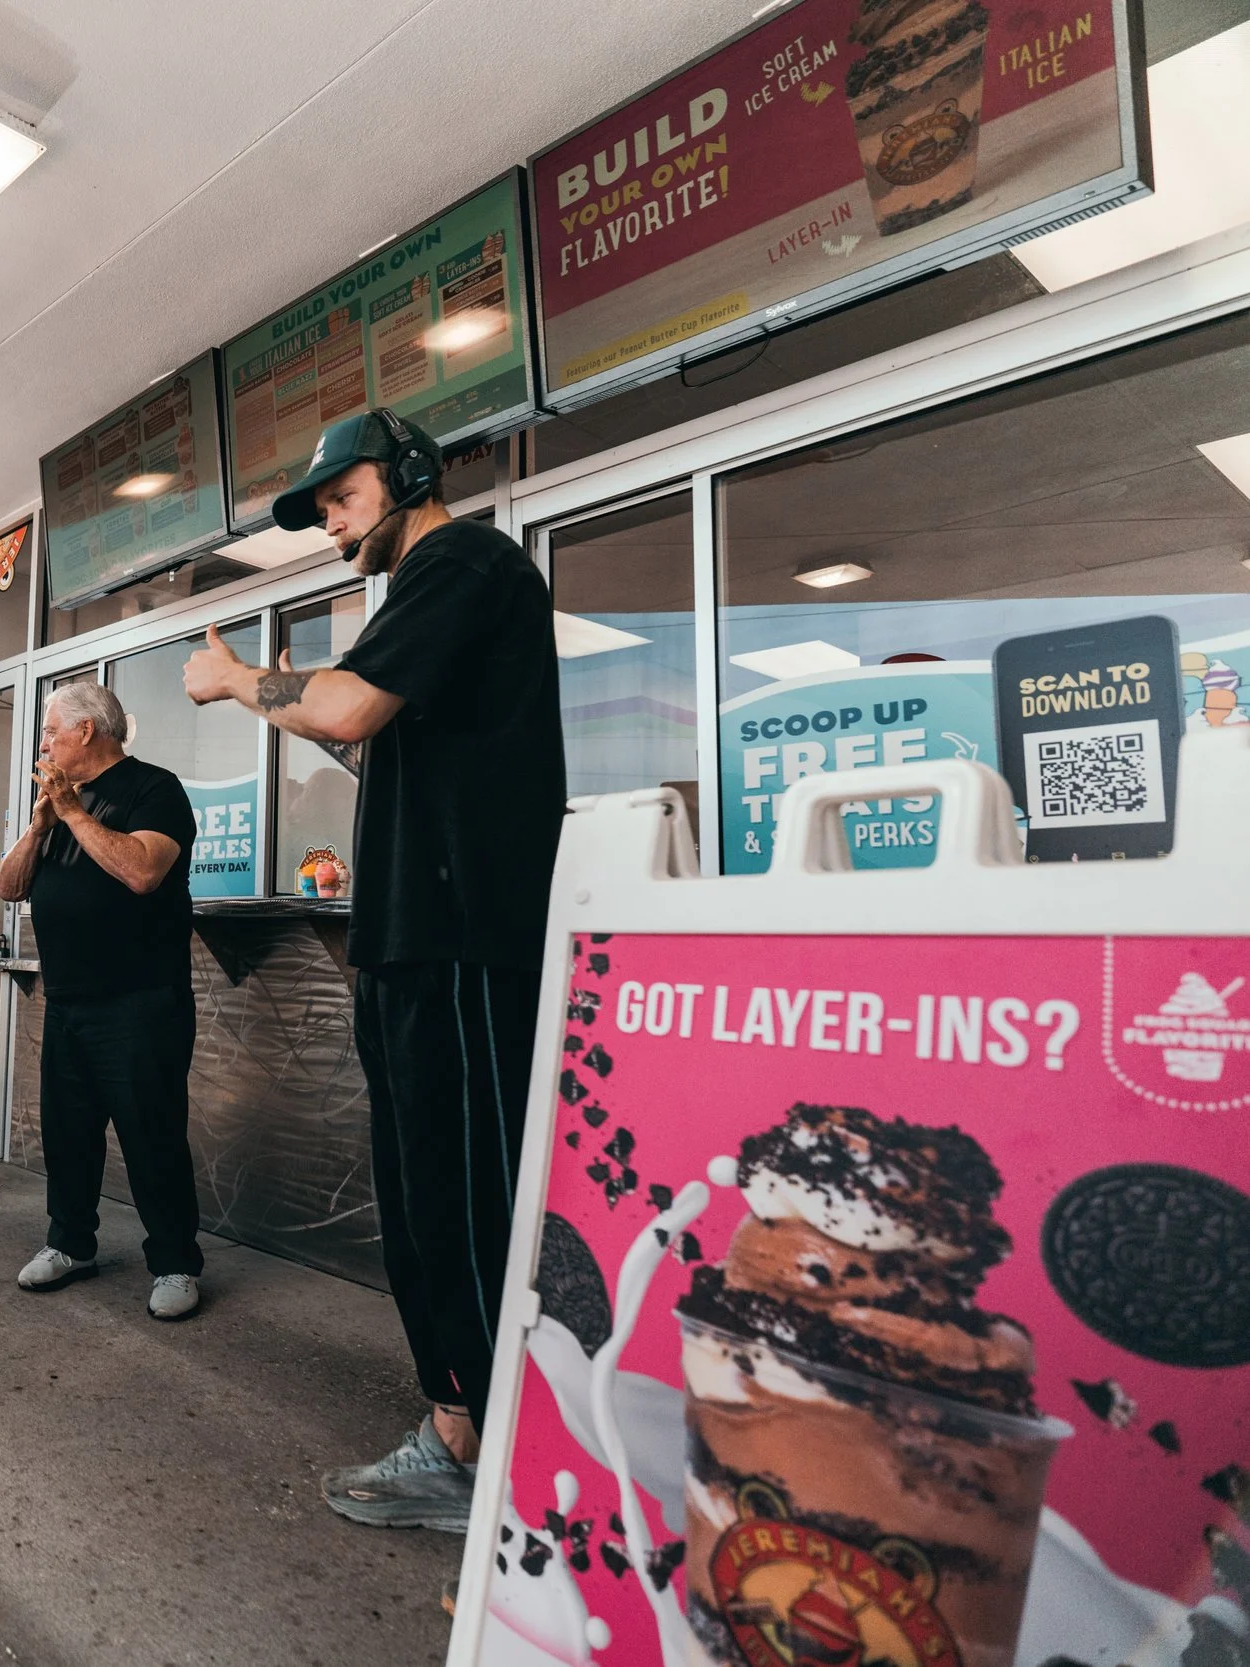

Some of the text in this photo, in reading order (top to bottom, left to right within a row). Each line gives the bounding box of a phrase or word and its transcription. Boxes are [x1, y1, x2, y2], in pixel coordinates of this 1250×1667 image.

[762, 37, 805, 79] SOFT
[1000, 14, 1093, 76] ITALIAN
[745, 40, 838, 116] ICE CREAM
[1028, 53, 1066, 89] ICE
[557, 88, 728, 210] BUILD
[560, 133, 728, 235] YOUR OWN
[560, 165, 730, 277] FLAVORITE!
[767, 202, 853, 264] LAYER-IN
[272, 297, 325, 339] BUILD
[328, 263, 386, 304] YOUR
[389, 226, 442, 270] OWN
[446, 254, 480, 279] LAYER-INS
[765, 300, 798, 318] Sylvox
[264, 334, 300, 368] ITALIAN
[305, 323, 321, 345] ICE
[620, 340, 648, 356] Peanut
[650, 327, 678, 345] Butter
[681, 318, 698, 334] Cup
[276, 349, 312, 373] CHOCOLATE
[326, 374, 356, 393] CHERRY
[1019, 662, 1150, 695] SCAN TO
[1022, 681, 1151, 718] DOWNLOAD
[740, 698, 928, 742] SCOOP UP
[743, 728, 927, 790] FREE
[744, 831, 762, 854] &
[855, 820, 934, 848] PERKS
[195, 861, 251, 874] EVERY DAY.
[616, 980, 1081, 1071] GOT LAYER-INS?
